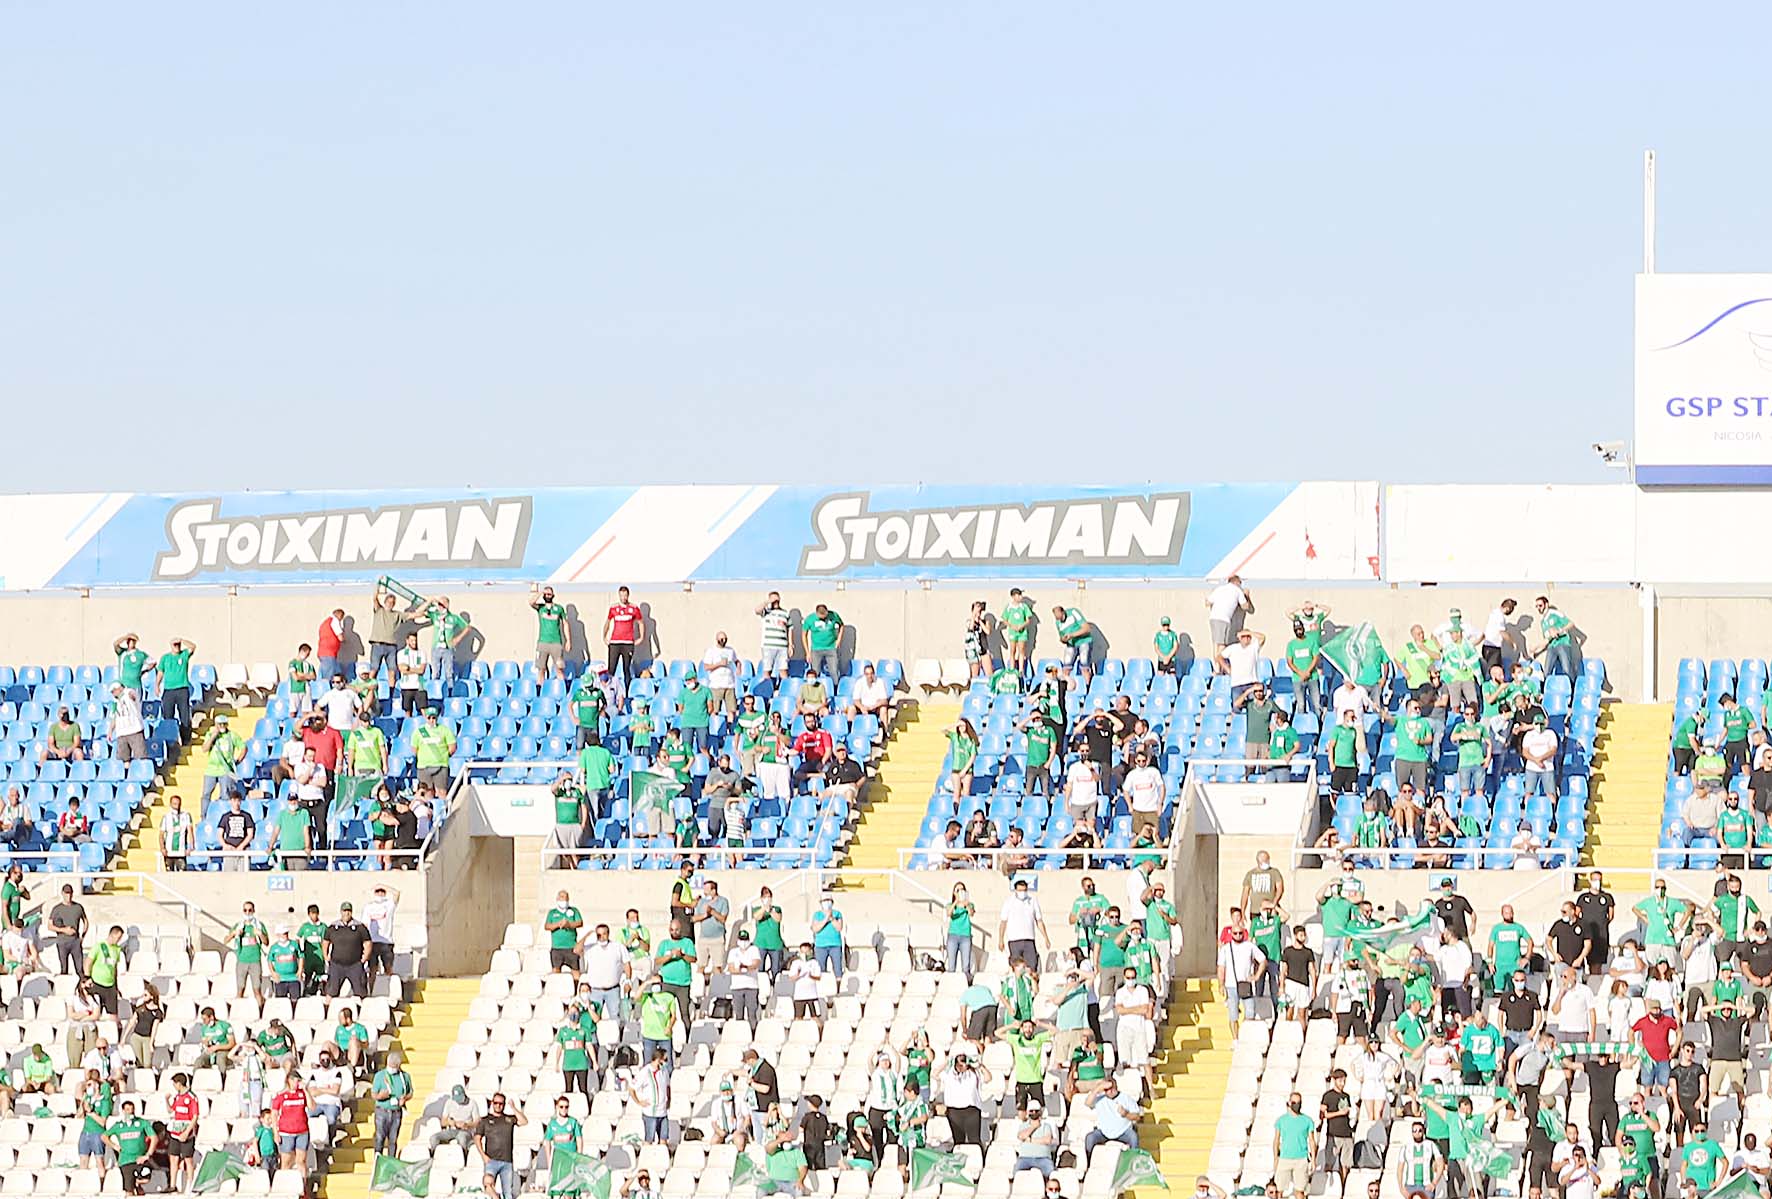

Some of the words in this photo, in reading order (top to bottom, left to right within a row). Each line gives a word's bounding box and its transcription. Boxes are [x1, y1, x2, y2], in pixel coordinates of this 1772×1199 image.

[1666, 395, 1724, 418] GSP
[1714, 430, 1763, 442] NICOSIA
[157, 498, 526, 577] STOIXIMAN
[803, 494, 1186, 573] STOIXIMAN
[269, 877, 294, 890] 221
